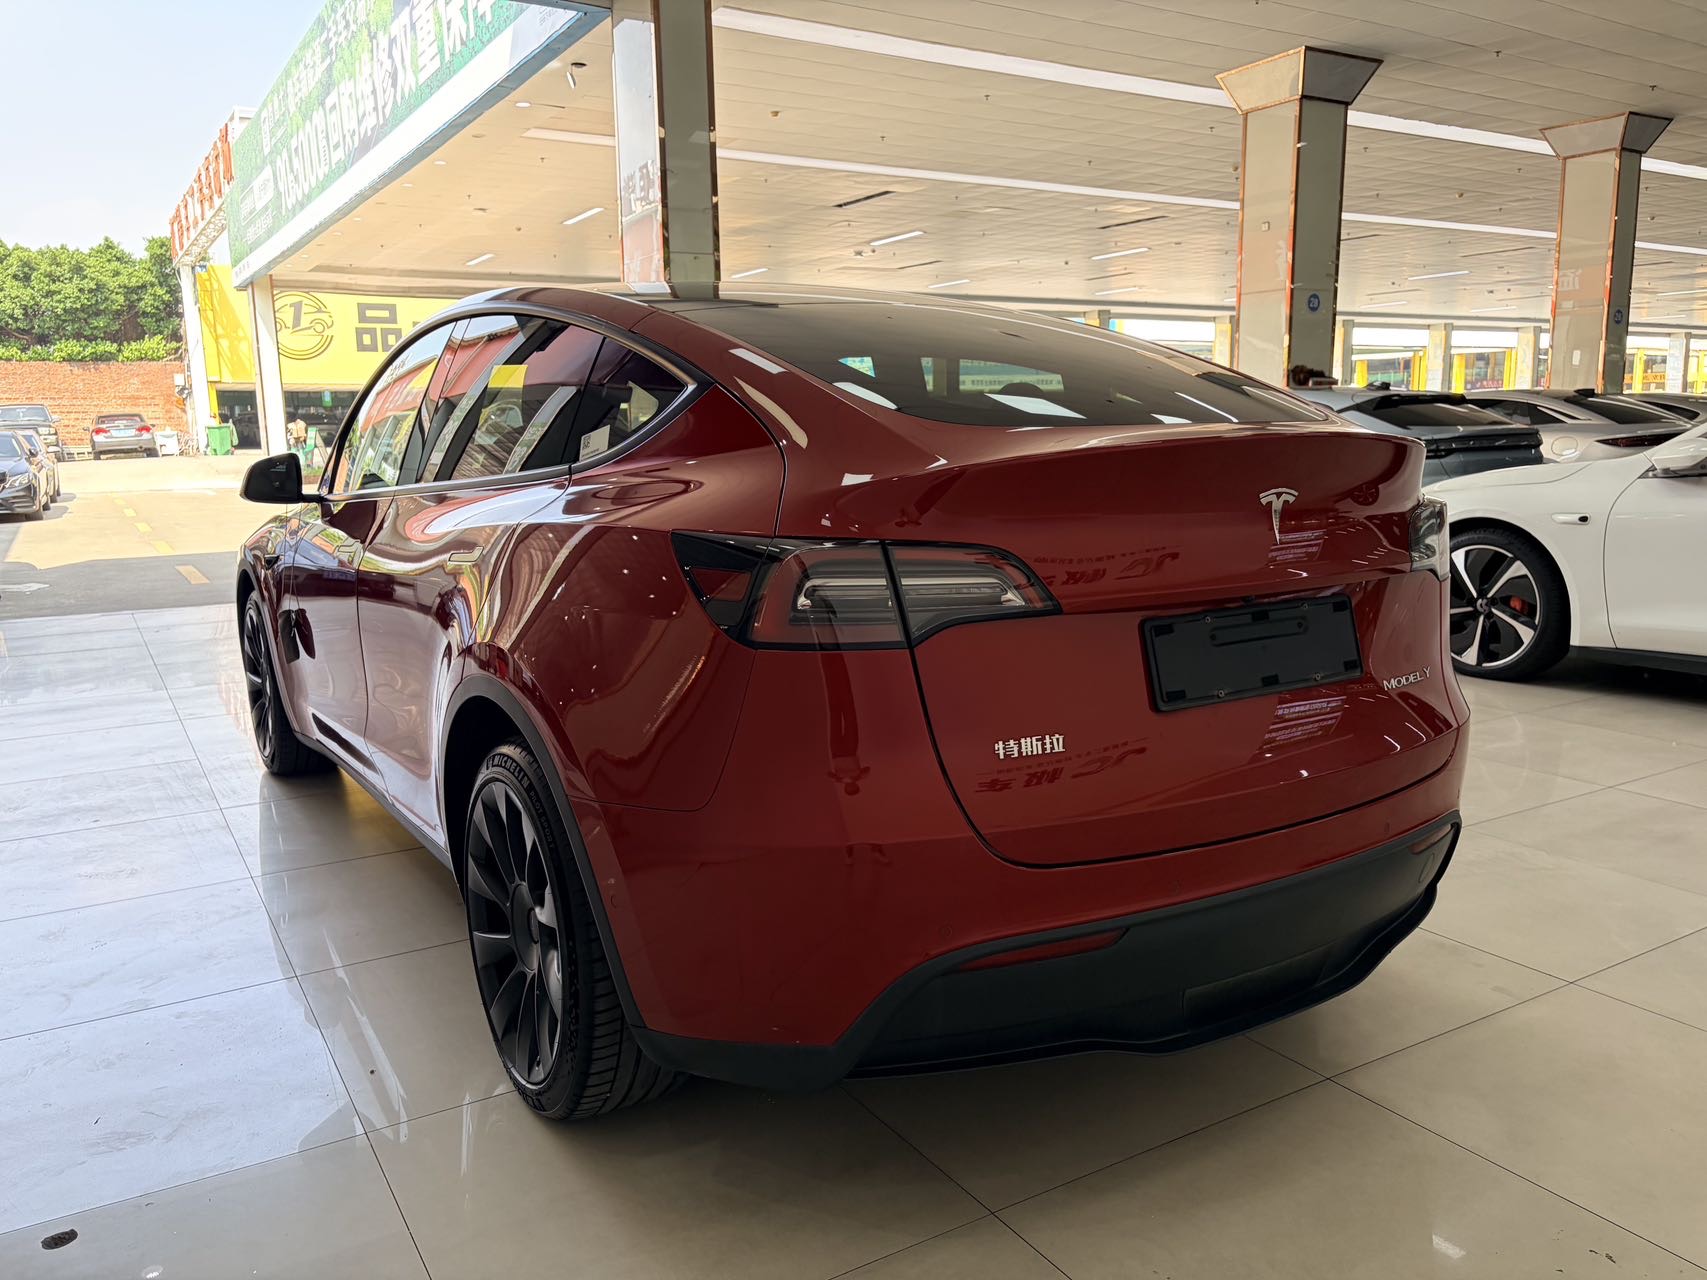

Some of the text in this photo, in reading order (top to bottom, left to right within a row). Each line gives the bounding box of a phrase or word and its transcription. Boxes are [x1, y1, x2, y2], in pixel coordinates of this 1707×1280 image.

[355, 302, 421, 352] 品
[1383, 667, 1431, 691] MODEL Y
[994, 734, 1066, 760] 特斯拉
[492, 755, 530, 787] MICHELIN
